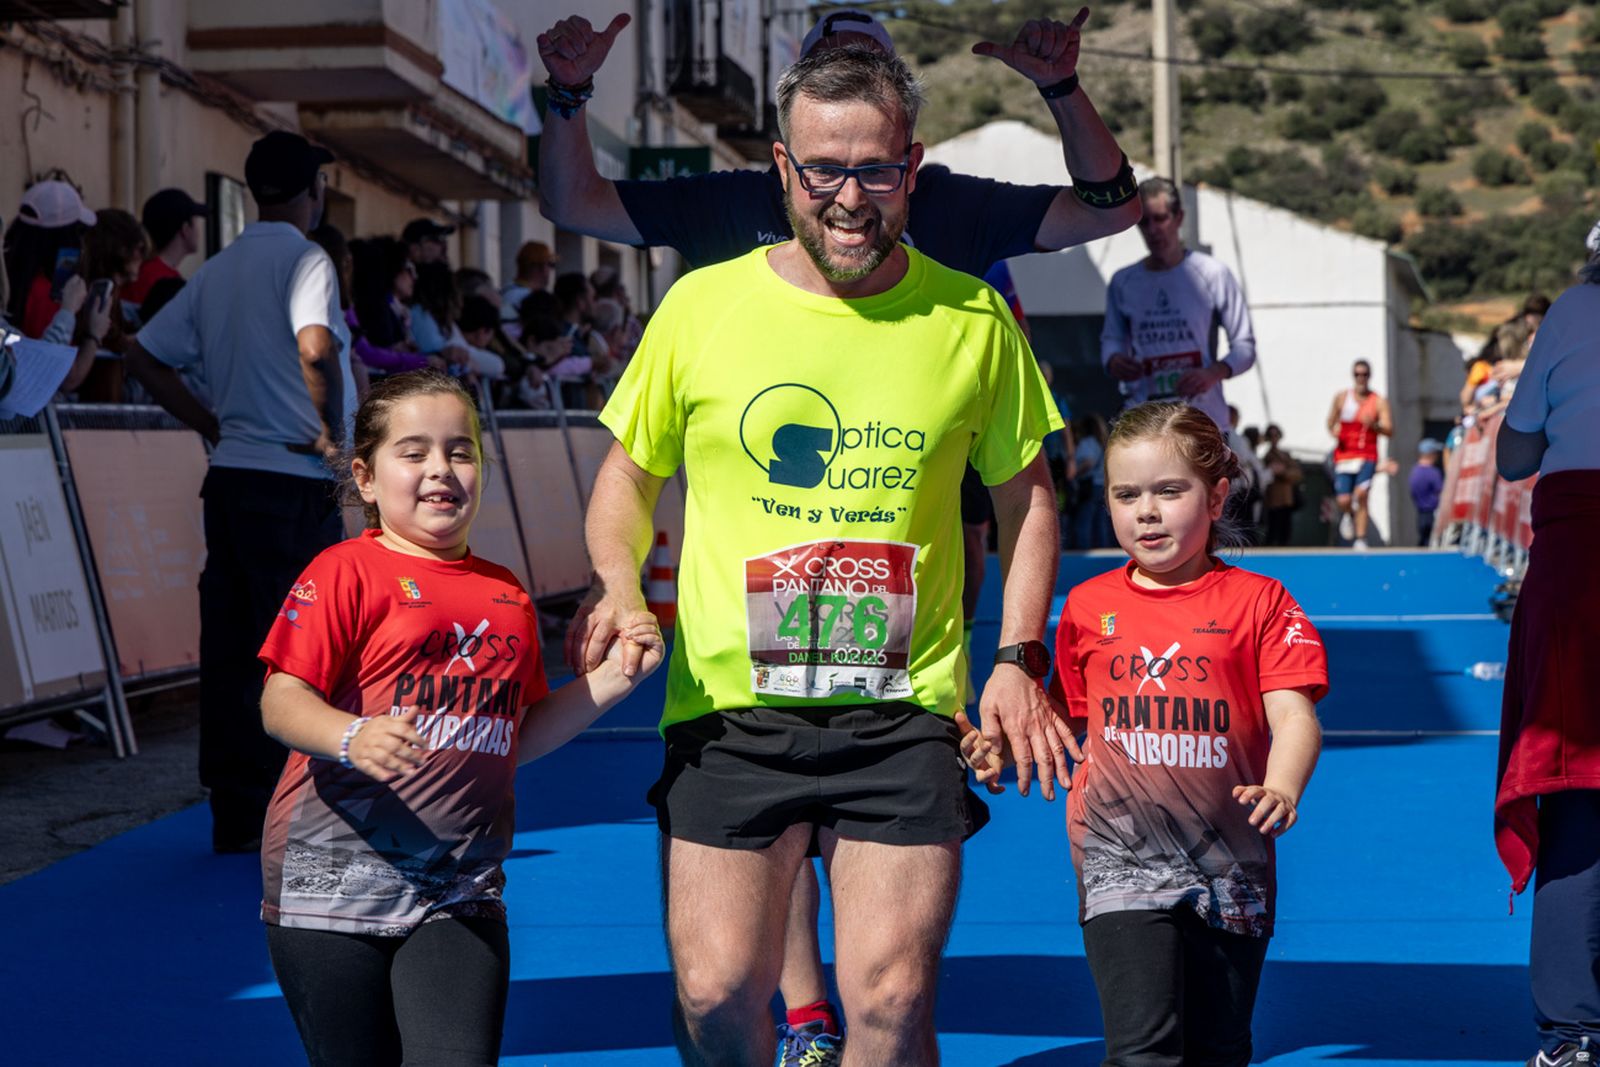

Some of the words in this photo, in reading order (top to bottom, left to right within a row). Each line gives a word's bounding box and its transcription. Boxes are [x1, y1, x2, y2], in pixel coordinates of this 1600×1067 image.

[808, 509, 823, 523] y
[804, 556, 890, 580] CROSS
[772, 578, 870, 598] PANTANO
[778, 594, 888, 649] 476
[421, 628, 521, 662] CROSS
[1109, 652, 1211, 683] CROSS
[392, 671, 521, 718] PANTANO
[1102, 695, 1230, 734] PANTANO
[1120, 723, 1229, 769] VÍBORAS
